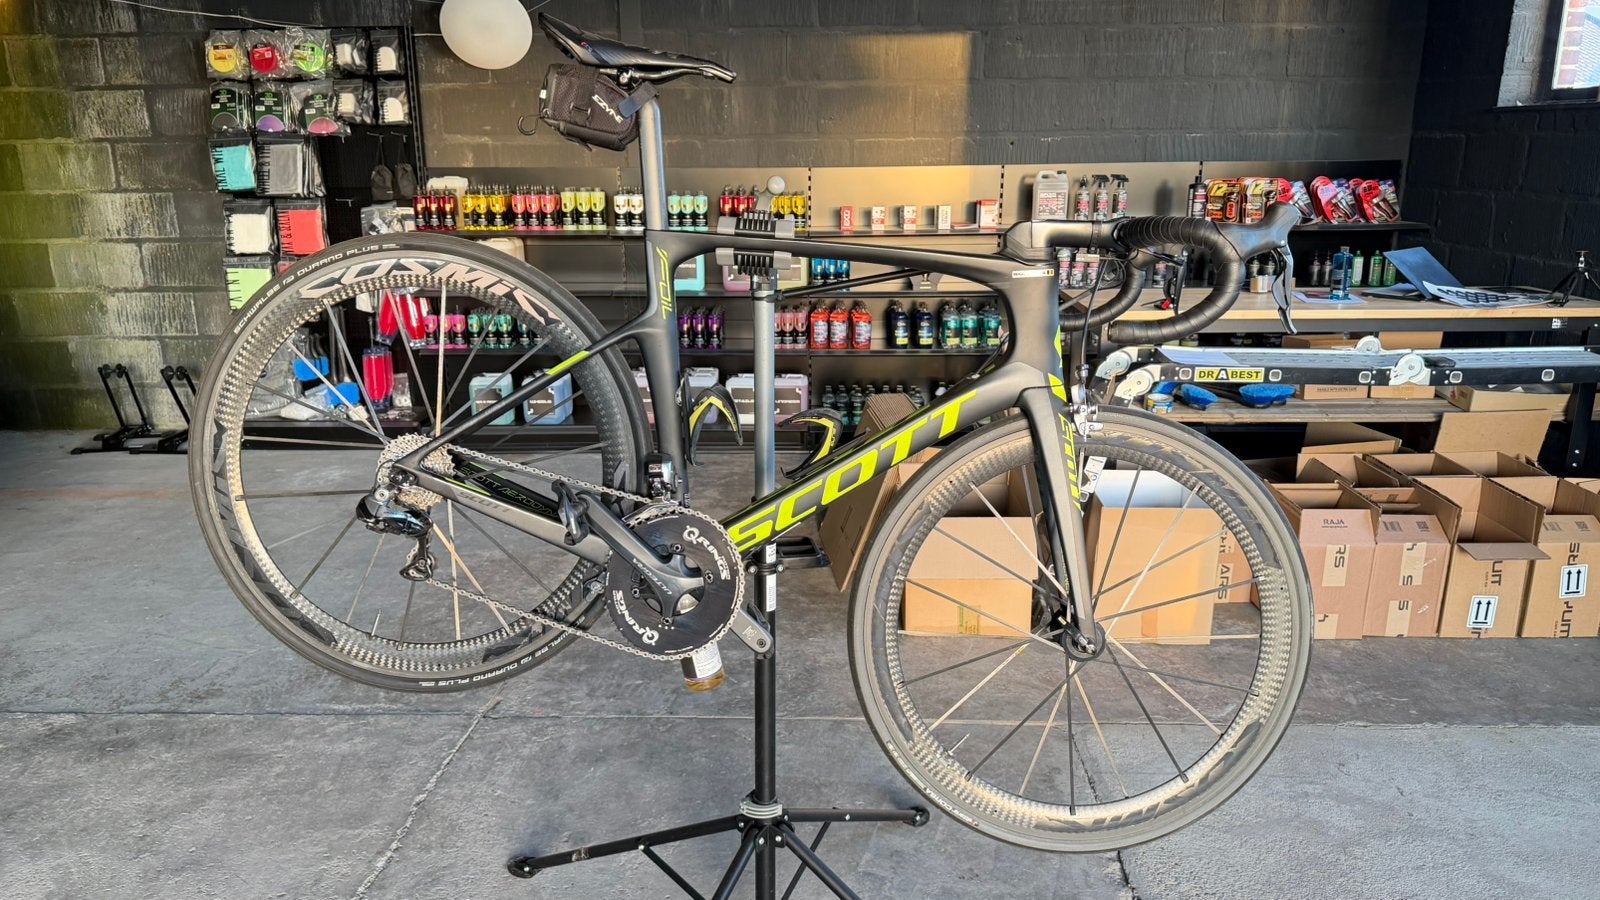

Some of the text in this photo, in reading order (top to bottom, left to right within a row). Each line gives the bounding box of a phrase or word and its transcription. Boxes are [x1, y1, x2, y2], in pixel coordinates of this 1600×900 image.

[210, 144, 230, 192] FINAL WIPE
[257, 168, 271, 194] WHEEL
[233, 244, 379, 334] SCHWALBE DURANO PLUS
[727, 389, 977, 552] SCOTT
[472, 663, 518, 682] DURANO
